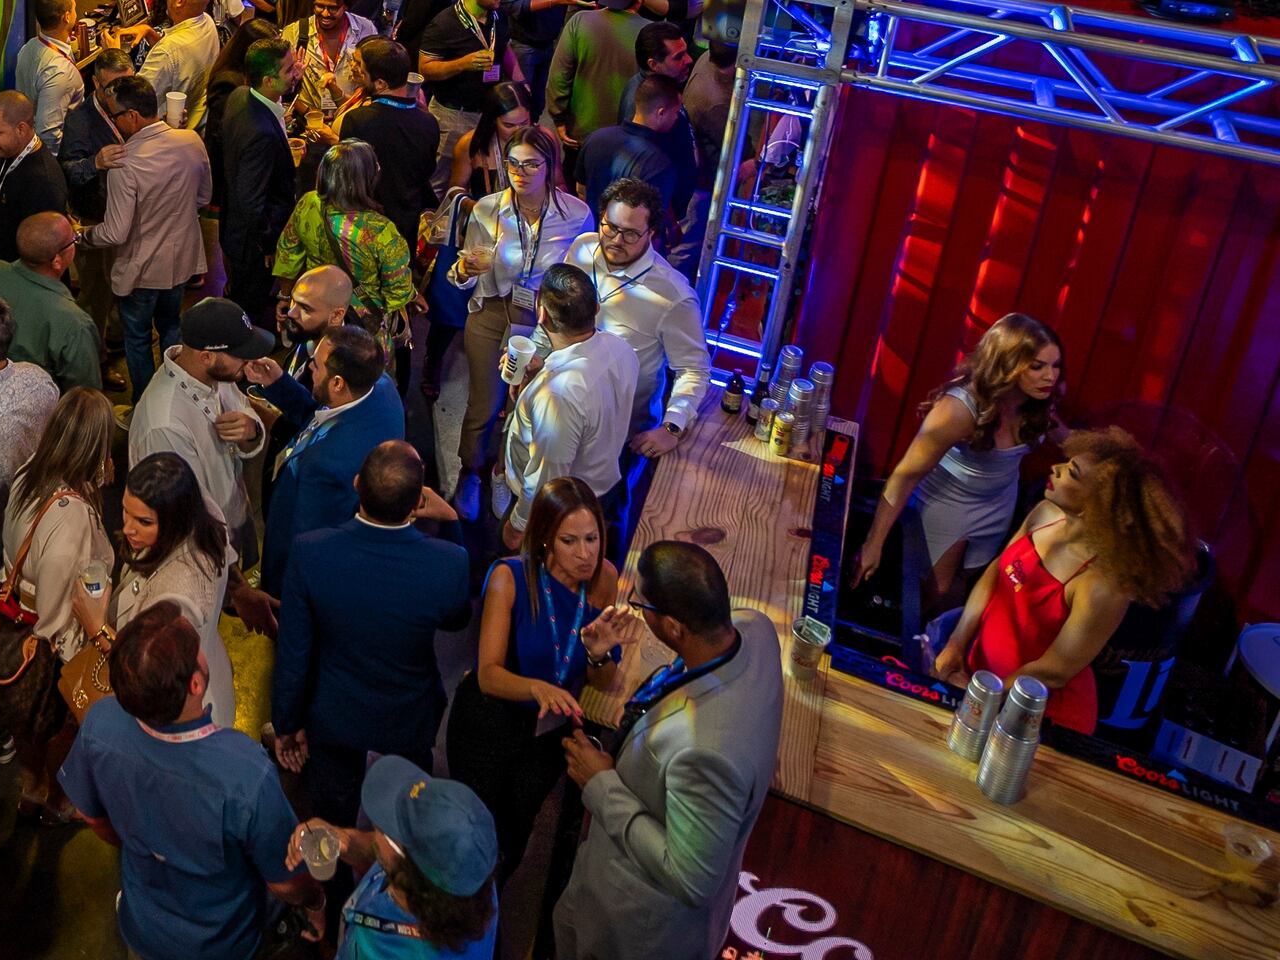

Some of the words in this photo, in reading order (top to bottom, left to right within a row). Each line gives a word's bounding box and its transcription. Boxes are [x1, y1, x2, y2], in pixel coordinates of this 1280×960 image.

[807, 582, 821, 614] LIGHT
[885, 670, 941, 702] Coors
[1115, 754, 1181, 790] Coors
[1181, 783, 1241, 812] LIGHT
